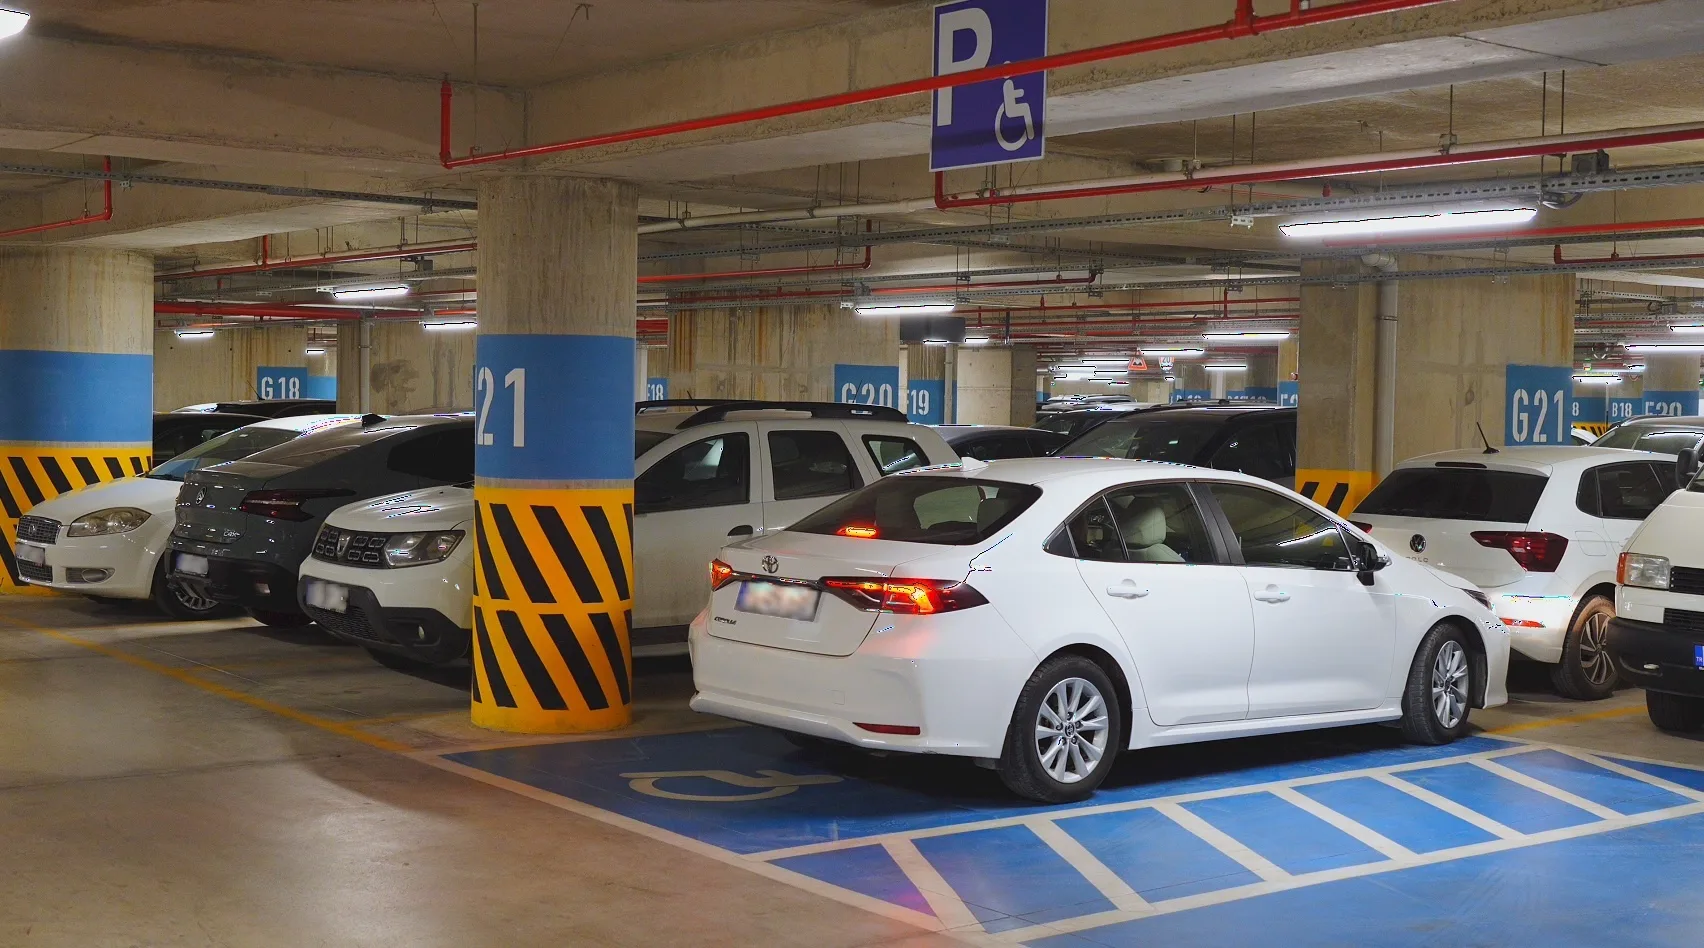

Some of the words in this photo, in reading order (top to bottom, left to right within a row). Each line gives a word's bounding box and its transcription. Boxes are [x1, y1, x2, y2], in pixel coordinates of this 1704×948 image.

[936, 7, 993, 127] P
[477, 366, 526, 447] 21
[1512, 388, 1564, 443] G21
[1612, 402, 1633, 417] B18
